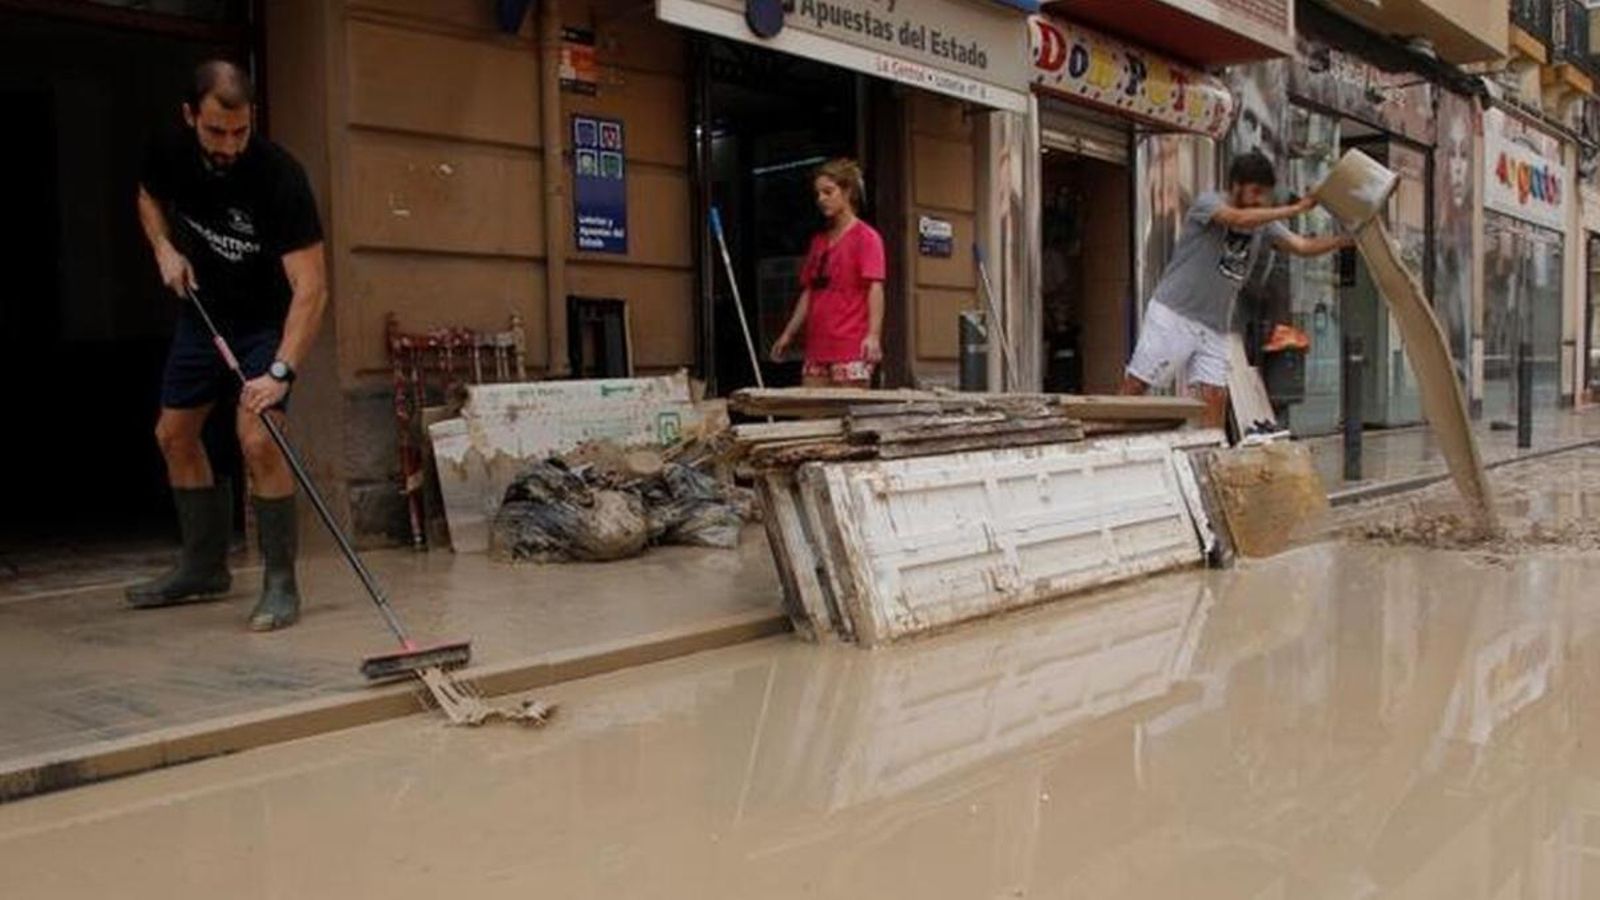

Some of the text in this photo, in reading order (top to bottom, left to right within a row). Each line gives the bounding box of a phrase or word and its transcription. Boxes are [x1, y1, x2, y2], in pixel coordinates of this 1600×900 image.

[800, 0, 987, 69] Apuestas del Estado
